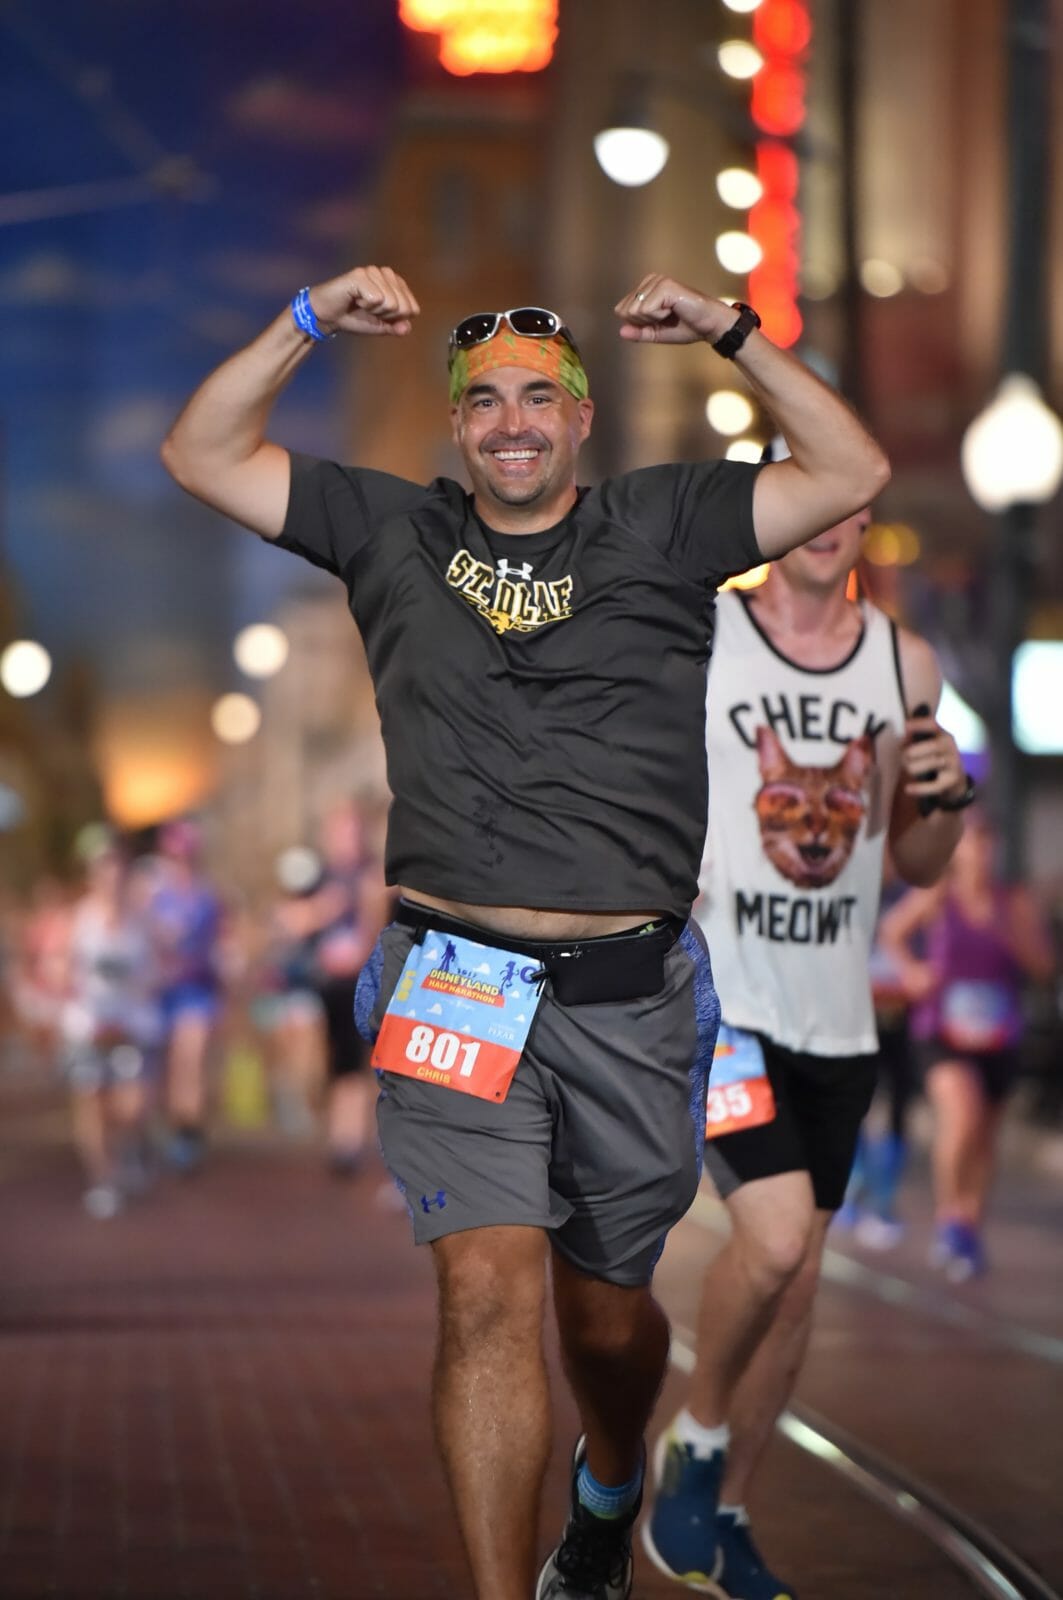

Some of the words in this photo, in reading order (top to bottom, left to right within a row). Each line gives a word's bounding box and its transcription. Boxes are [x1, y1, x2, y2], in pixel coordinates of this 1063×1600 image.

[492, 575, 573, 625] OLAF
[729, 693, 888, 750] CHECK
[428, 979, 448, 990] HALF
[448, 984, 496, 1005] MARATHON
[429, 968, 499, 996] DISNEYLAND
[405, 1025, 480, 1078] 801
[416, 1066, 451, 1084] CHRIS
